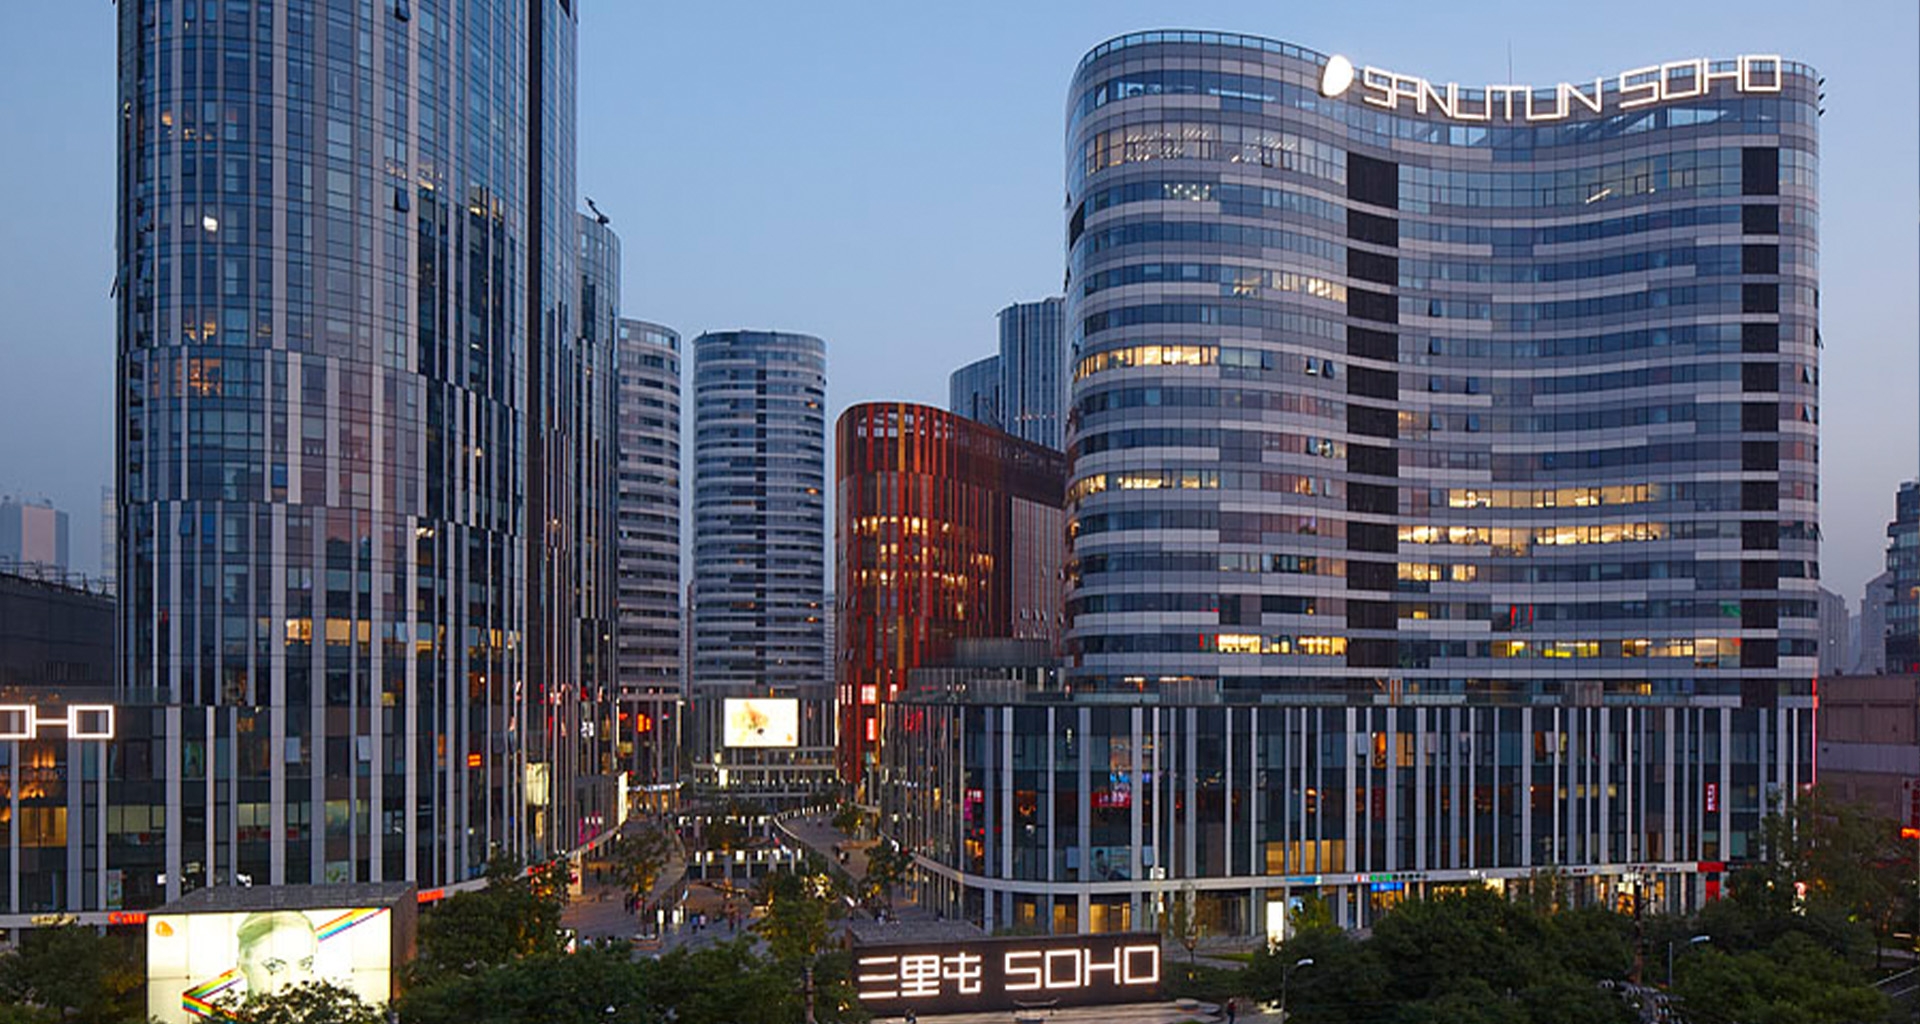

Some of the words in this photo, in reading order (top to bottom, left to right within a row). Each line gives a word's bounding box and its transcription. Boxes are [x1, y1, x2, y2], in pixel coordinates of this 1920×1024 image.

[1363, 65, 1603, 122] SANLITUN
[1618, 54, 1782, 109] SOHO
[858, 952, 981, 999] 三里屯
[1004, 945, 1159, 991] SOHO
